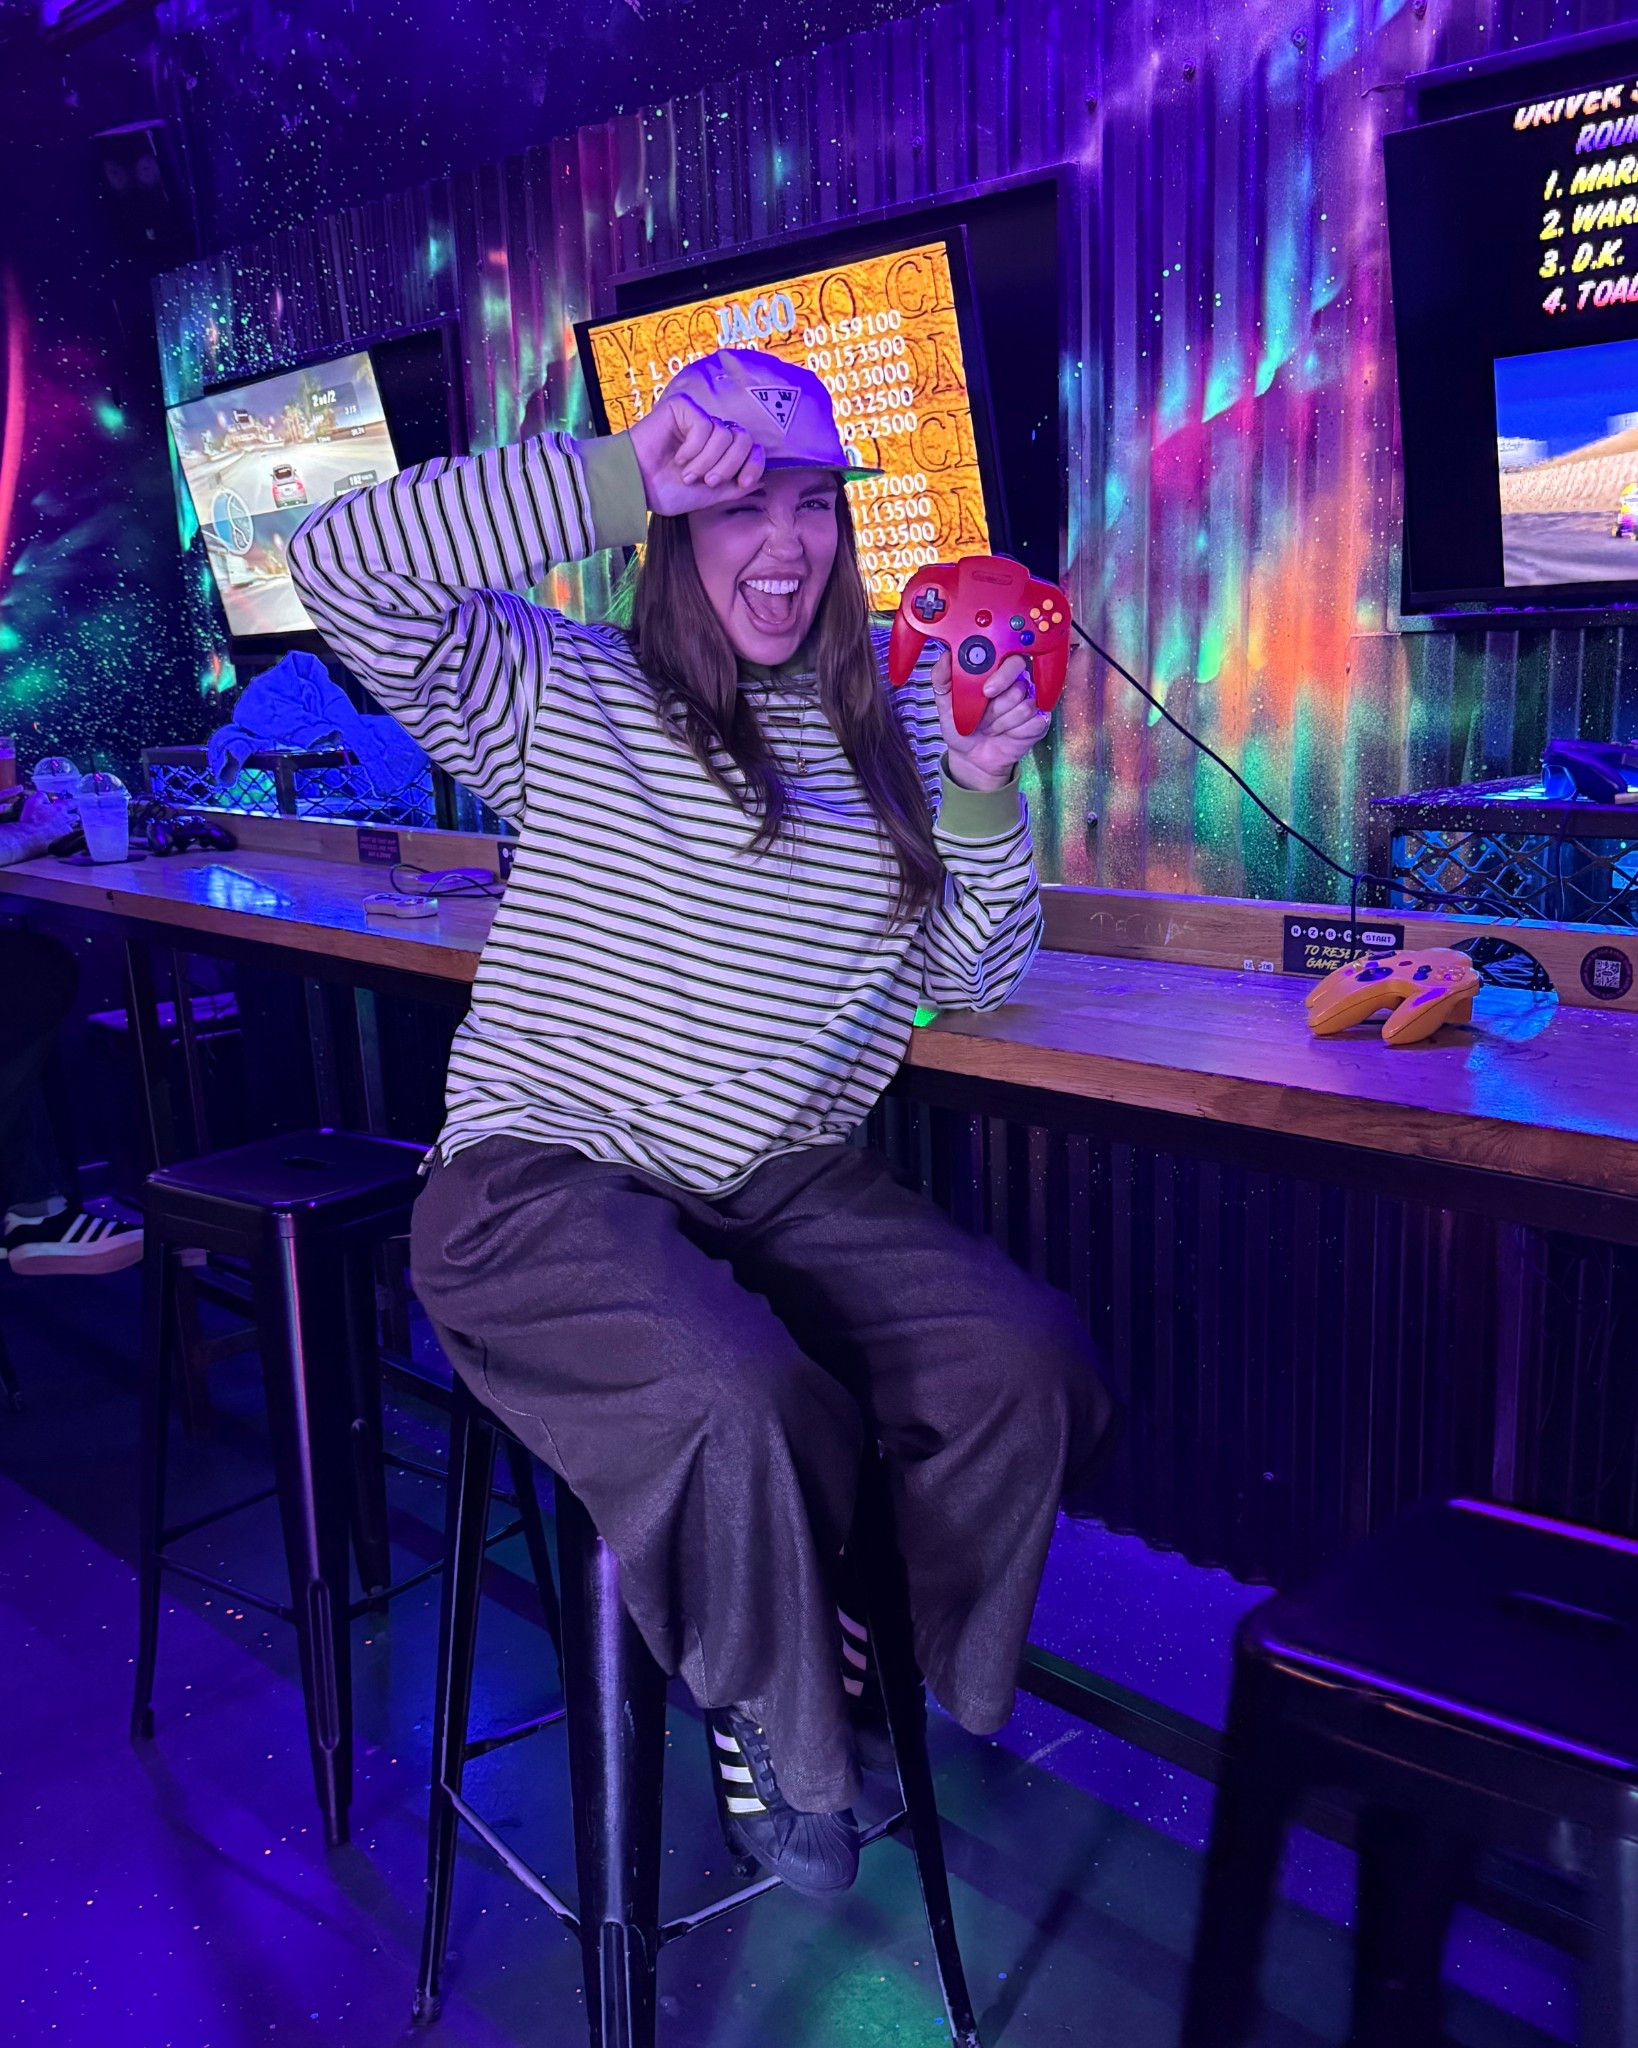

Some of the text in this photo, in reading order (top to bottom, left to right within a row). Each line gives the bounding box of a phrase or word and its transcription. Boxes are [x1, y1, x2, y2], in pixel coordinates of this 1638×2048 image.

[1544, 170, 1563, 200] 1.
[1539, 209, 1565, 240] 2.
[1539, 248, 1566, 278] 3.
[1542, 286, 1567, 314] 4.
[716, 293, 796, 346] JAGO
[803, 309, 901, 348] 00159100
[807, 335, 906, 373] 00153500
[759, 391, 792, 402] U W
[776, 411, 786, 424] T
[1304, 944, 1320, 955] TO
[1365, 934, 1392, 943] START
[1306, 958, 1341, 970] GAME
